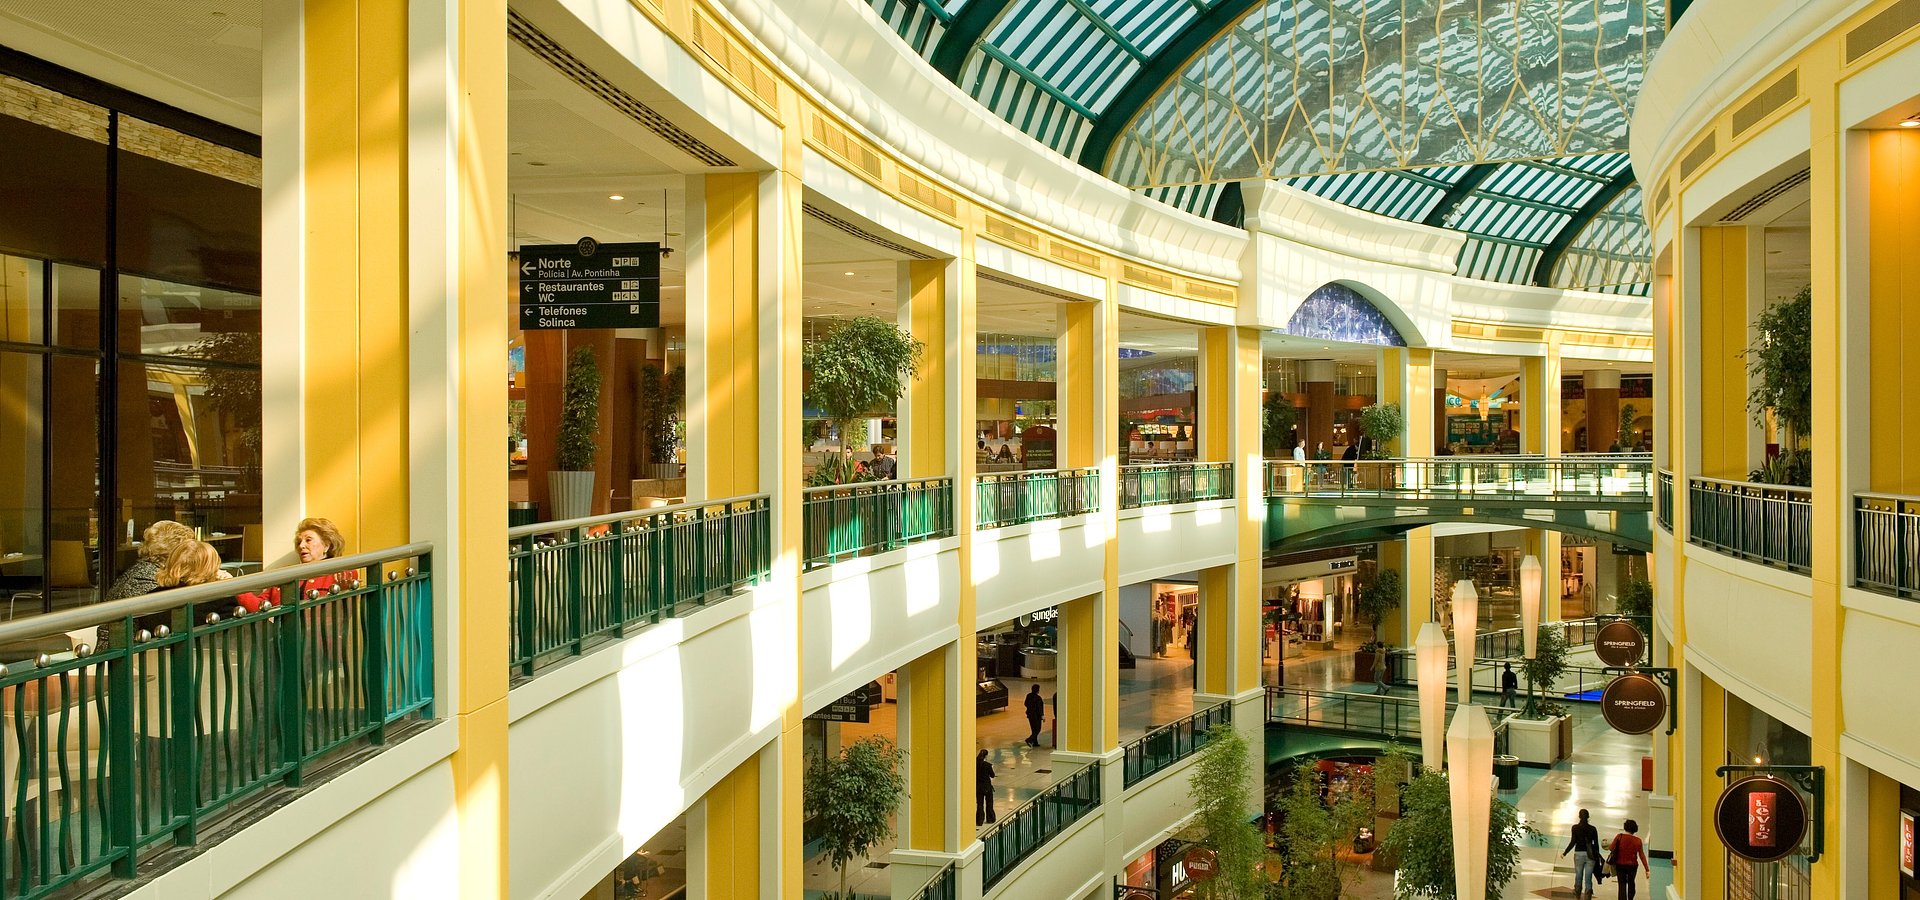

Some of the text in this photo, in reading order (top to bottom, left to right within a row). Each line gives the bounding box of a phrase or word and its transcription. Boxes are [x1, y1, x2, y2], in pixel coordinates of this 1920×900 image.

[539, 258, 571, 269] Norte
[585, 269, 620, 277] Pontinha
[539, 282, 605, 292] Restaurantes
[539, 293, 555, 303] WC
[539, 306, 588, 316] Telefones
[539, 318, 576, 327] Solinca
